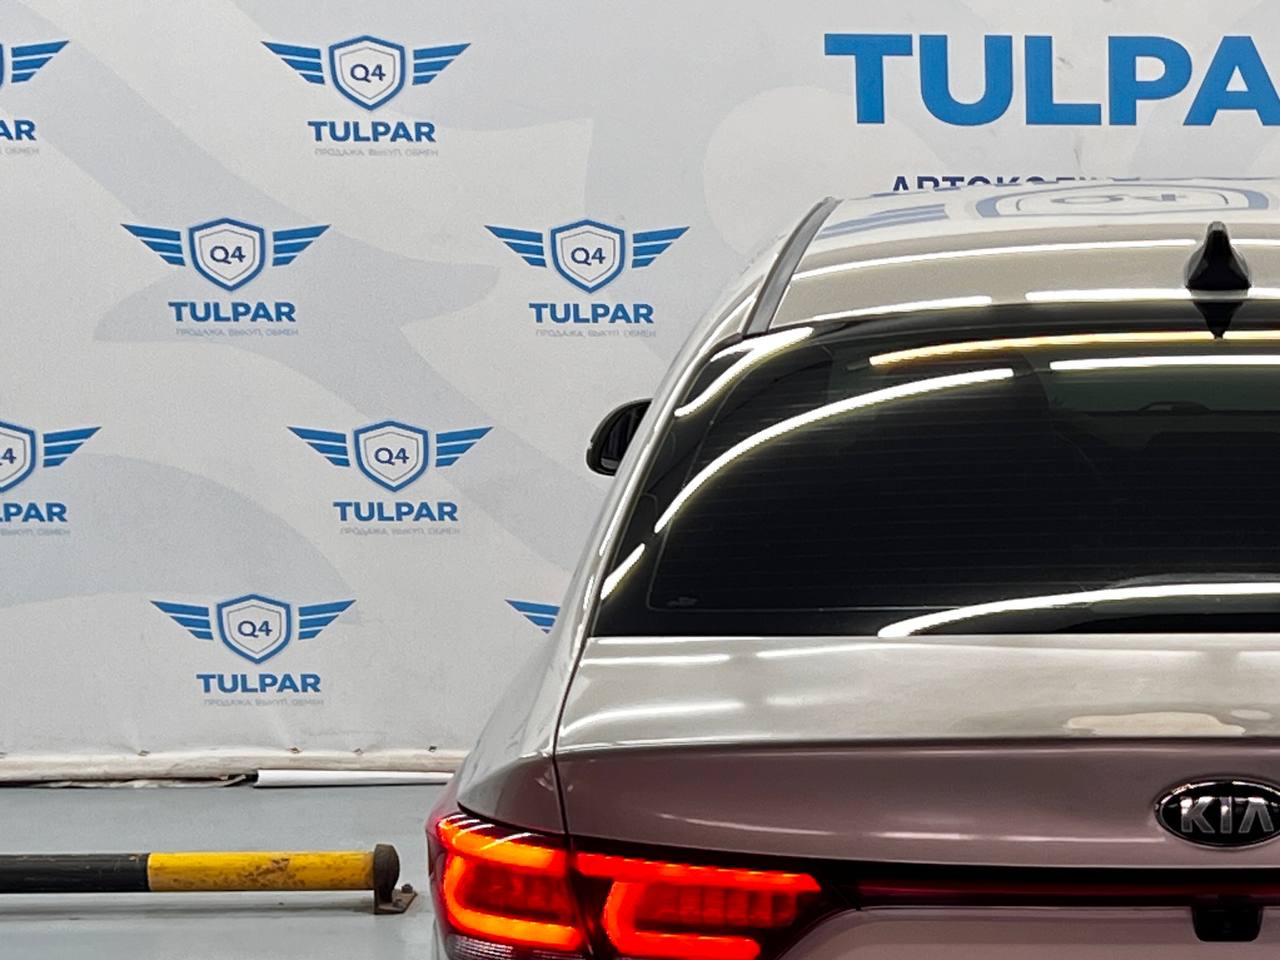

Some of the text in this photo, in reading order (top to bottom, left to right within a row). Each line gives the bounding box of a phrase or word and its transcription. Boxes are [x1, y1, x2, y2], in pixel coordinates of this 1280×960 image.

[351, 64, 385, 82] Q4
[309, 120, 436, 143] TULPAR
[210, 246, 245, 264] Q4
[571, 248, 605, 266] Q4
[169, 301, 296, 323] TULPAR
[528, 302, 654, 324] TULPAR
[0, 447, 17, 465] 4
[375, 448, 409, 465] Q4
[0, 502, 68, 523] PAR
[335, 501, 458, 522] TULPAR
[238, 621, 272, 638] Q4
[197, 673, 321, 694] TULPAR
[1179, 796, 1275, 834] KIA
